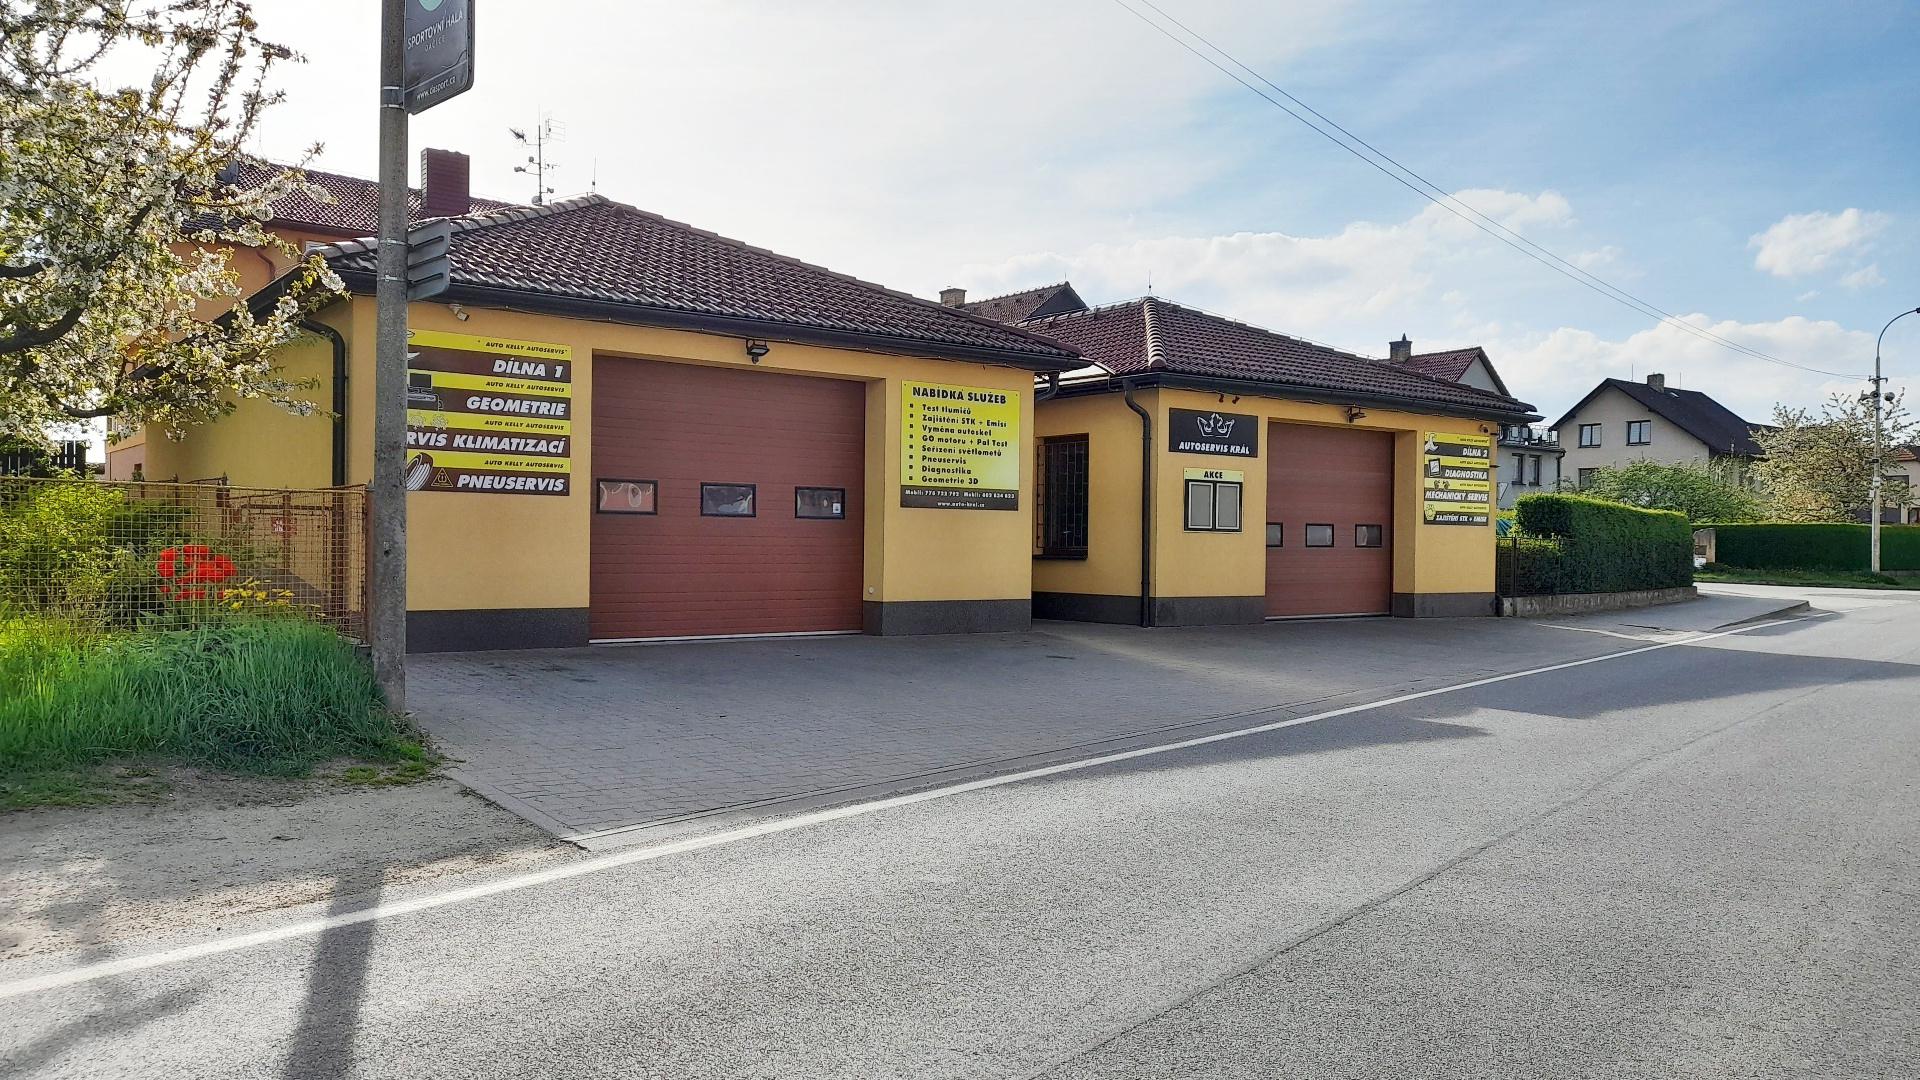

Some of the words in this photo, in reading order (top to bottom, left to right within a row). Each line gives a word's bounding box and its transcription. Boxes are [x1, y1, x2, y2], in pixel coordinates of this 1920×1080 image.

[407, 16, 445, 50] SPORTOVNÍ
[445, 8, 463, 29] HALA
[526, 345, 565, 354] AUTOSERVIS
[493, 357, 546, 377] DÍLNA
[554, 365, 564, 378] 1
[526, 384, 565, 393] AUTOSERVIS
[912, 386, 964, 401] NABÍDKA
[967, 391, 1007, 404] SLUŽEB
[466, 396, 567, 416] GEOMETRIE
[922, 403, 939, 412] Test
[525, 423, 565, 431] AUTOSERVIS
[961, 417, 976, 426] STK
[957, 427, 992, 437] autoskel
[406, 431, 448, 447] RVIS
[452, 435, 566, 454] KLIMATIZACÍ
[921, 434, 935, 443] GO
[937, 437, 966, 445] motoru
[992, 439, 1008, 448] Test
[1179, 441, 1229, 453] AUTOSERVIS
[1229, 444, 1250, 455] KRÁL
[1462, 446, 1481, 457] DÍLNA
[1482, 449, 1488, 457] 2
[921, 455, 967, 465] Pneuservis
[921, 465, 972, 475] Diagnostika
[1203, 470, 1223, 479] AKCE
[1444, 468, 1488, 480] DIAGNOSTIKA
[456, 474, 565, 492] PNEUSERVIS
[921, 475, 965, 485] Geometrie
[968, 477, 979, 485] 3D
[1425, 490, 1466, 500] MECHANICKÝ
[1467, 492, 1488, 501] SERVIS
